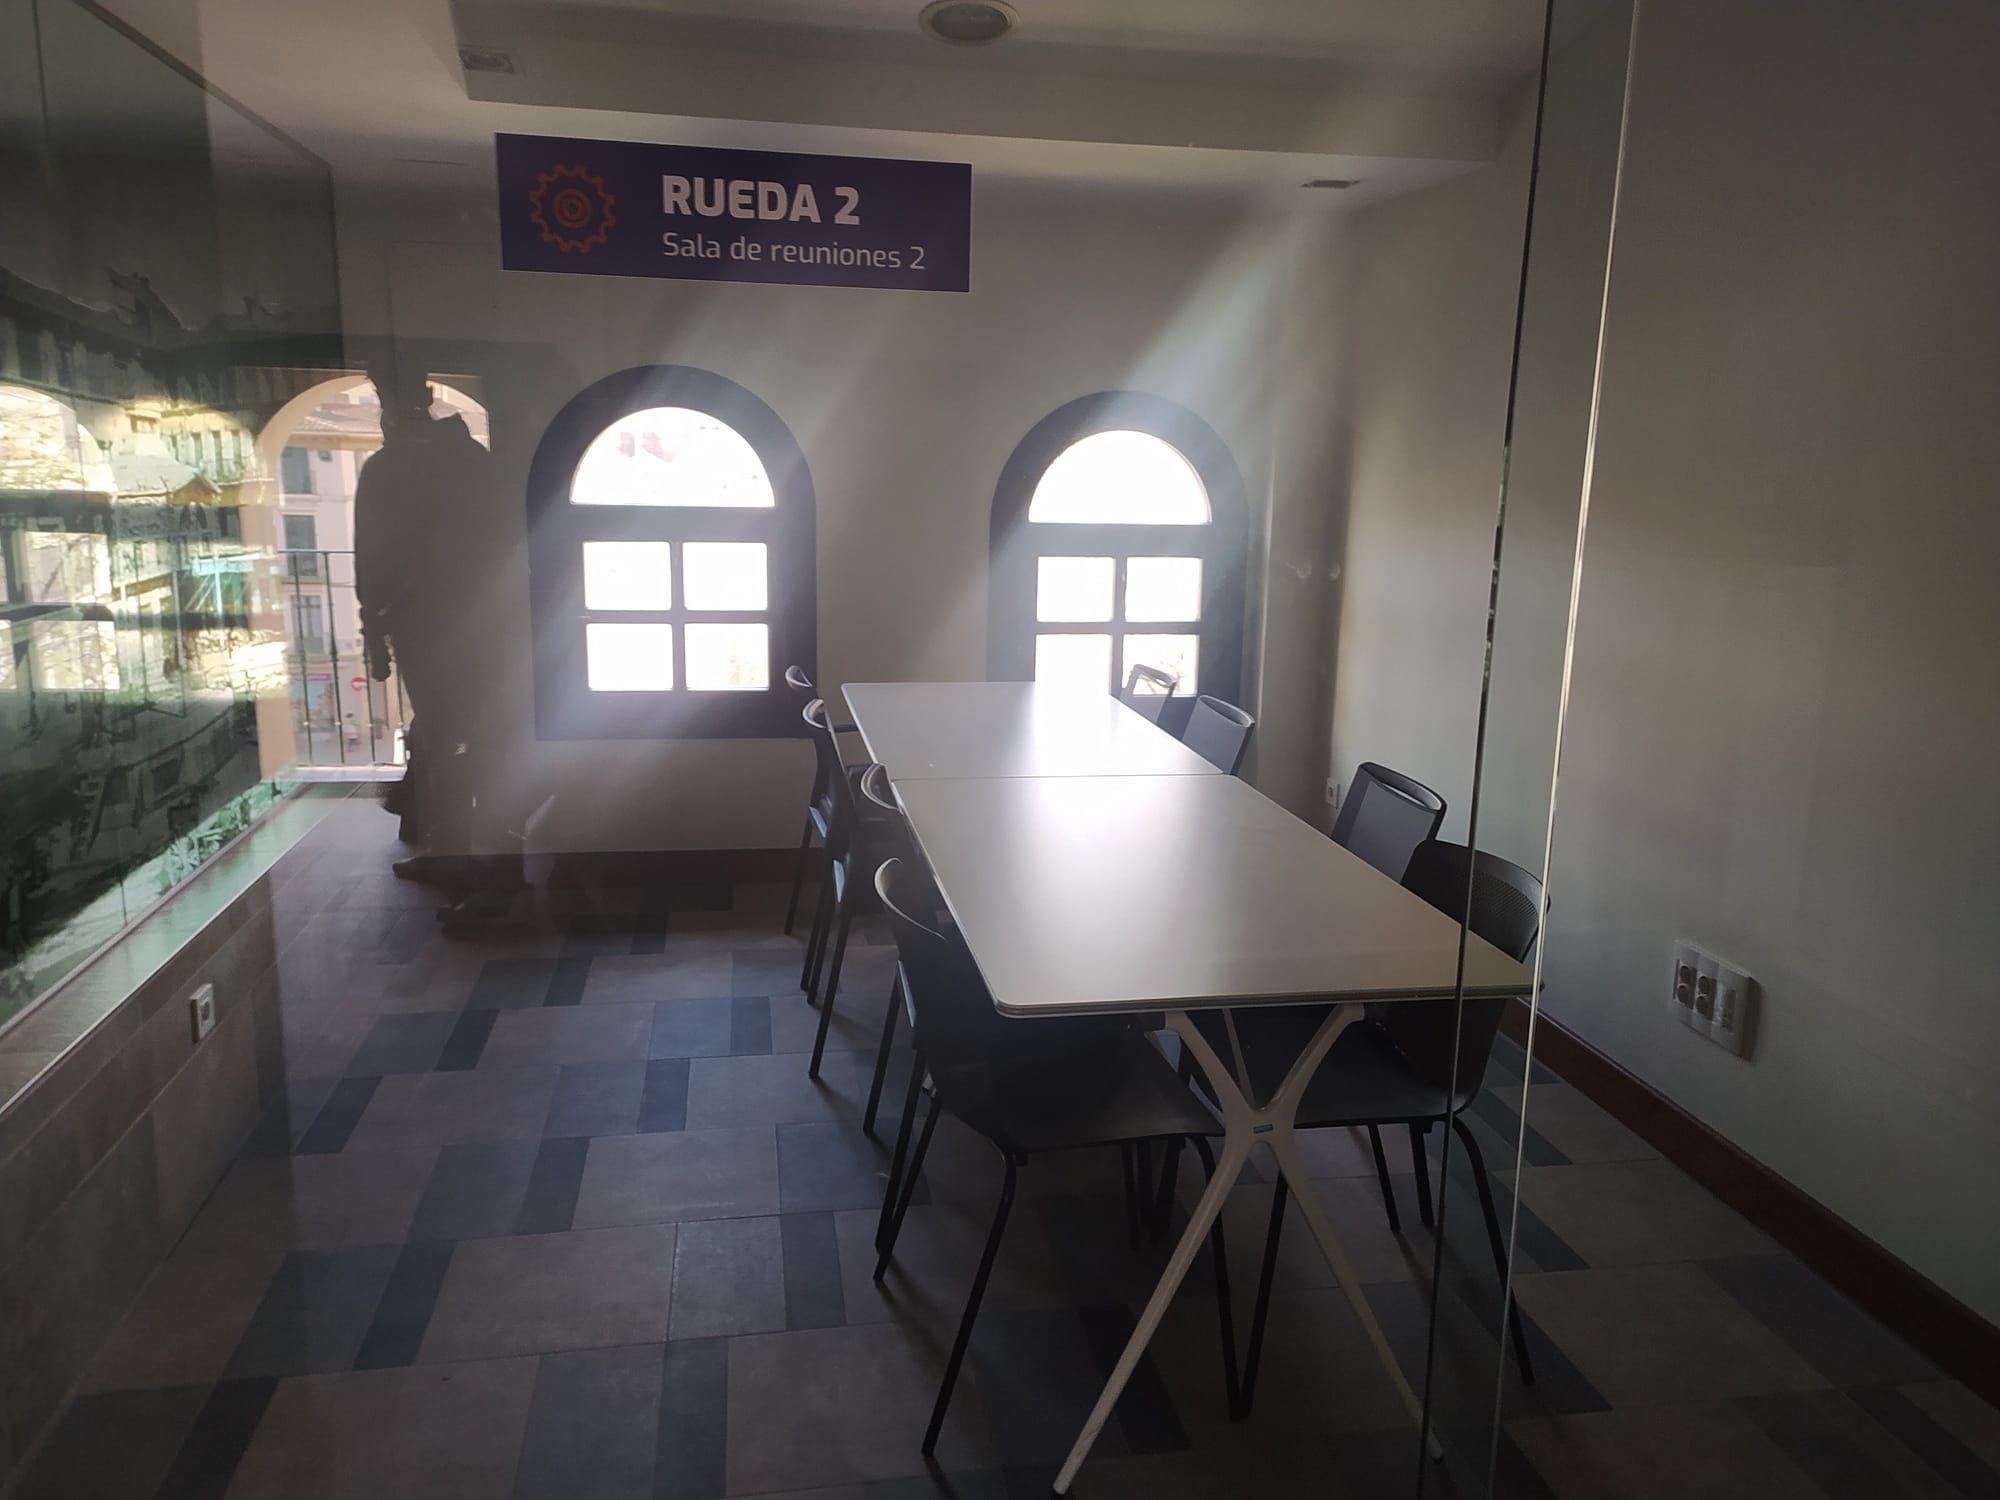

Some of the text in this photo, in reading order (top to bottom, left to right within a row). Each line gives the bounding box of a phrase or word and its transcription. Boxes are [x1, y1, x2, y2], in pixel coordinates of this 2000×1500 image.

[662, 174, 860, 226] RUEDA 2
[662, 232, 926, 270] Sala de reuniones 2
